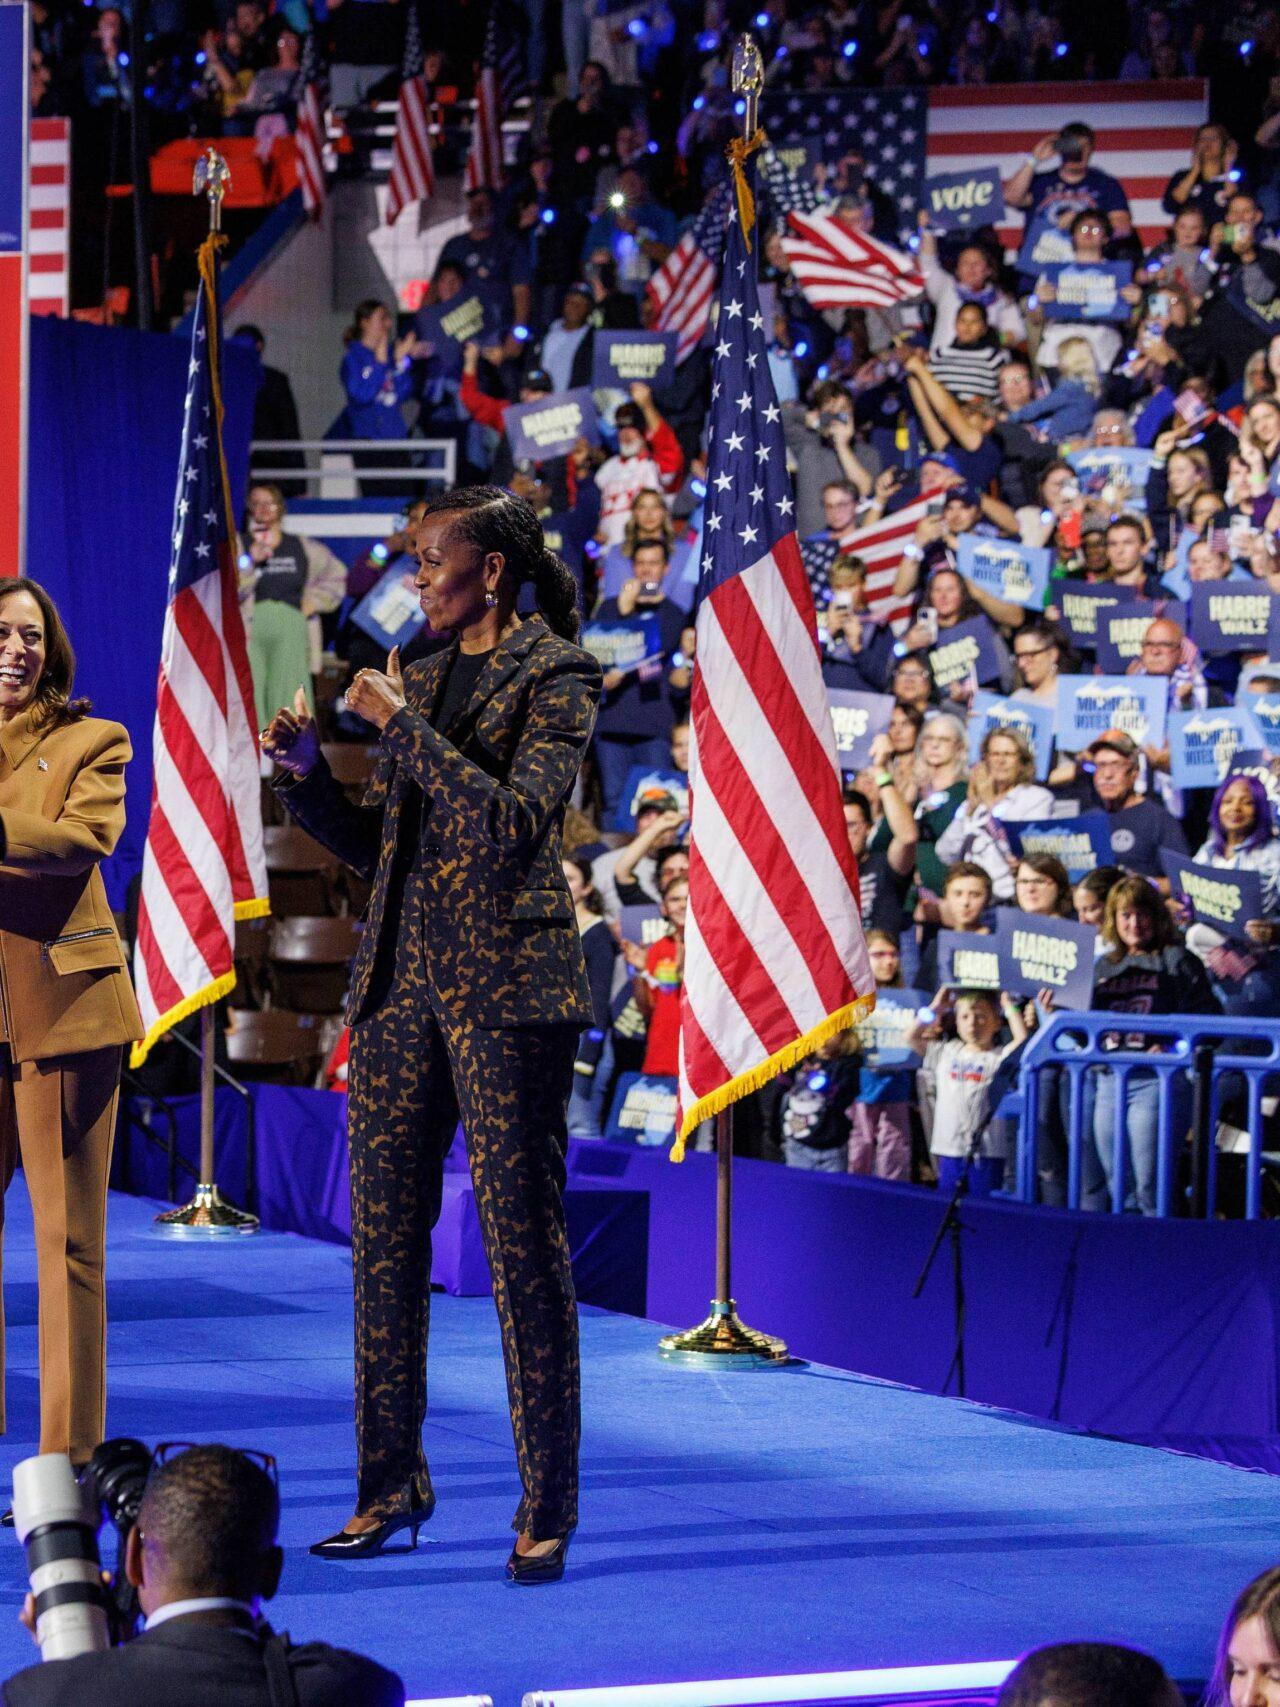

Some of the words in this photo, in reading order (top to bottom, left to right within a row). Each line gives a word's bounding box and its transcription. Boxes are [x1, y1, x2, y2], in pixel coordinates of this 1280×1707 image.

[929, 180, 994, 212] vote
[1180, 870, 1242, 911] HARRIS
[1191, 896, 1236, 923] WALZ
[954, 950, 999, 981] HARRI
[1012, 930, 1078, 971] HARRIS
[1021, 960, 1068, 986] WALZ
